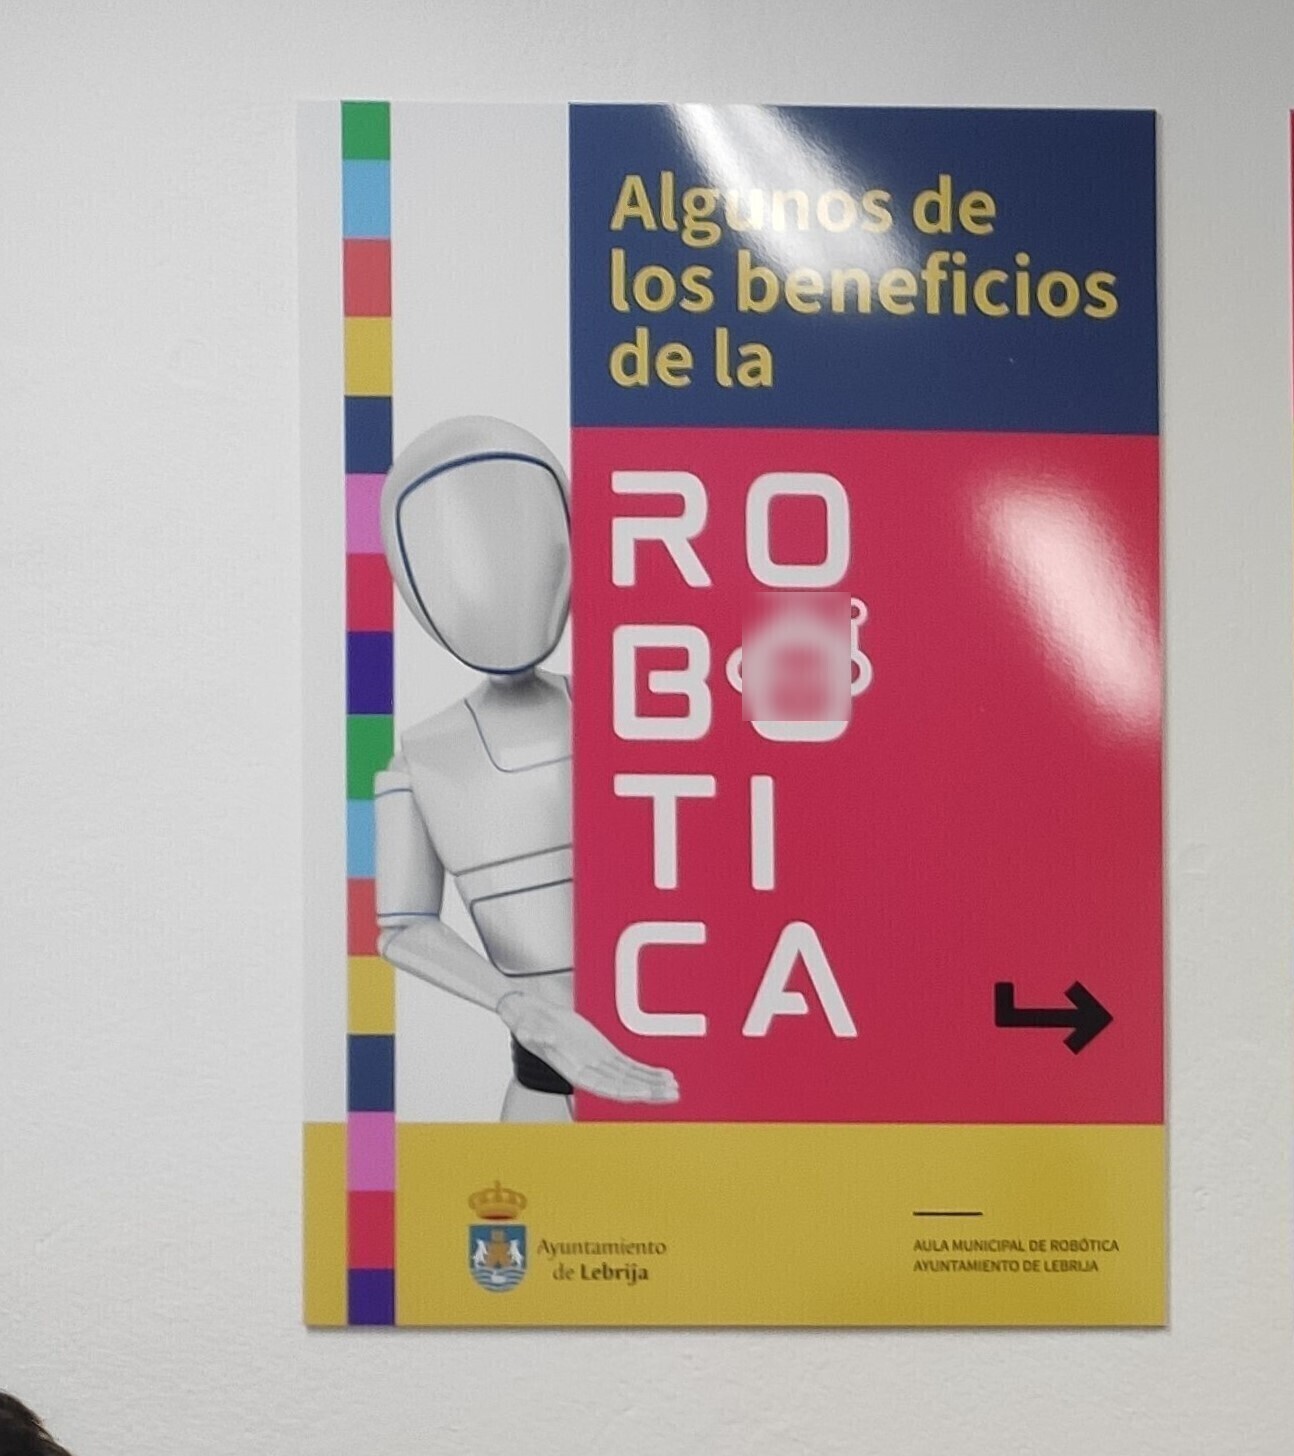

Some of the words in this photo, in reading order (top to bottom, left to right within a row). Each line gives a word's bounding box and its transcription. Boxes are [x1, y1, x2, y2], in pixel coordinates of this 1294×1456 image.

[611, 171, 893, 247] Algunos
[913, 174, 997, 236] de
[611, 249, 714, 312] los
[739, 247, 1118, 317] beneficios
[610, 326, 693, 387] de
[716, 327, 772, 387] la
[536, 1237, 667, 1260] Ayuntamiento
[913, 1239, 949, 1252] AULA
[952, 1239, 1026, 1252] MUNICIPAL
[1050, 1238, 1119, 1252] ROBÓTICA
[581, 1262, 649, 1286] Lebrija
[913, 1260, 1020, 1273] AYUNTAMIENTO
[1044, 1260, 1099, 1272] LEBRIJA
